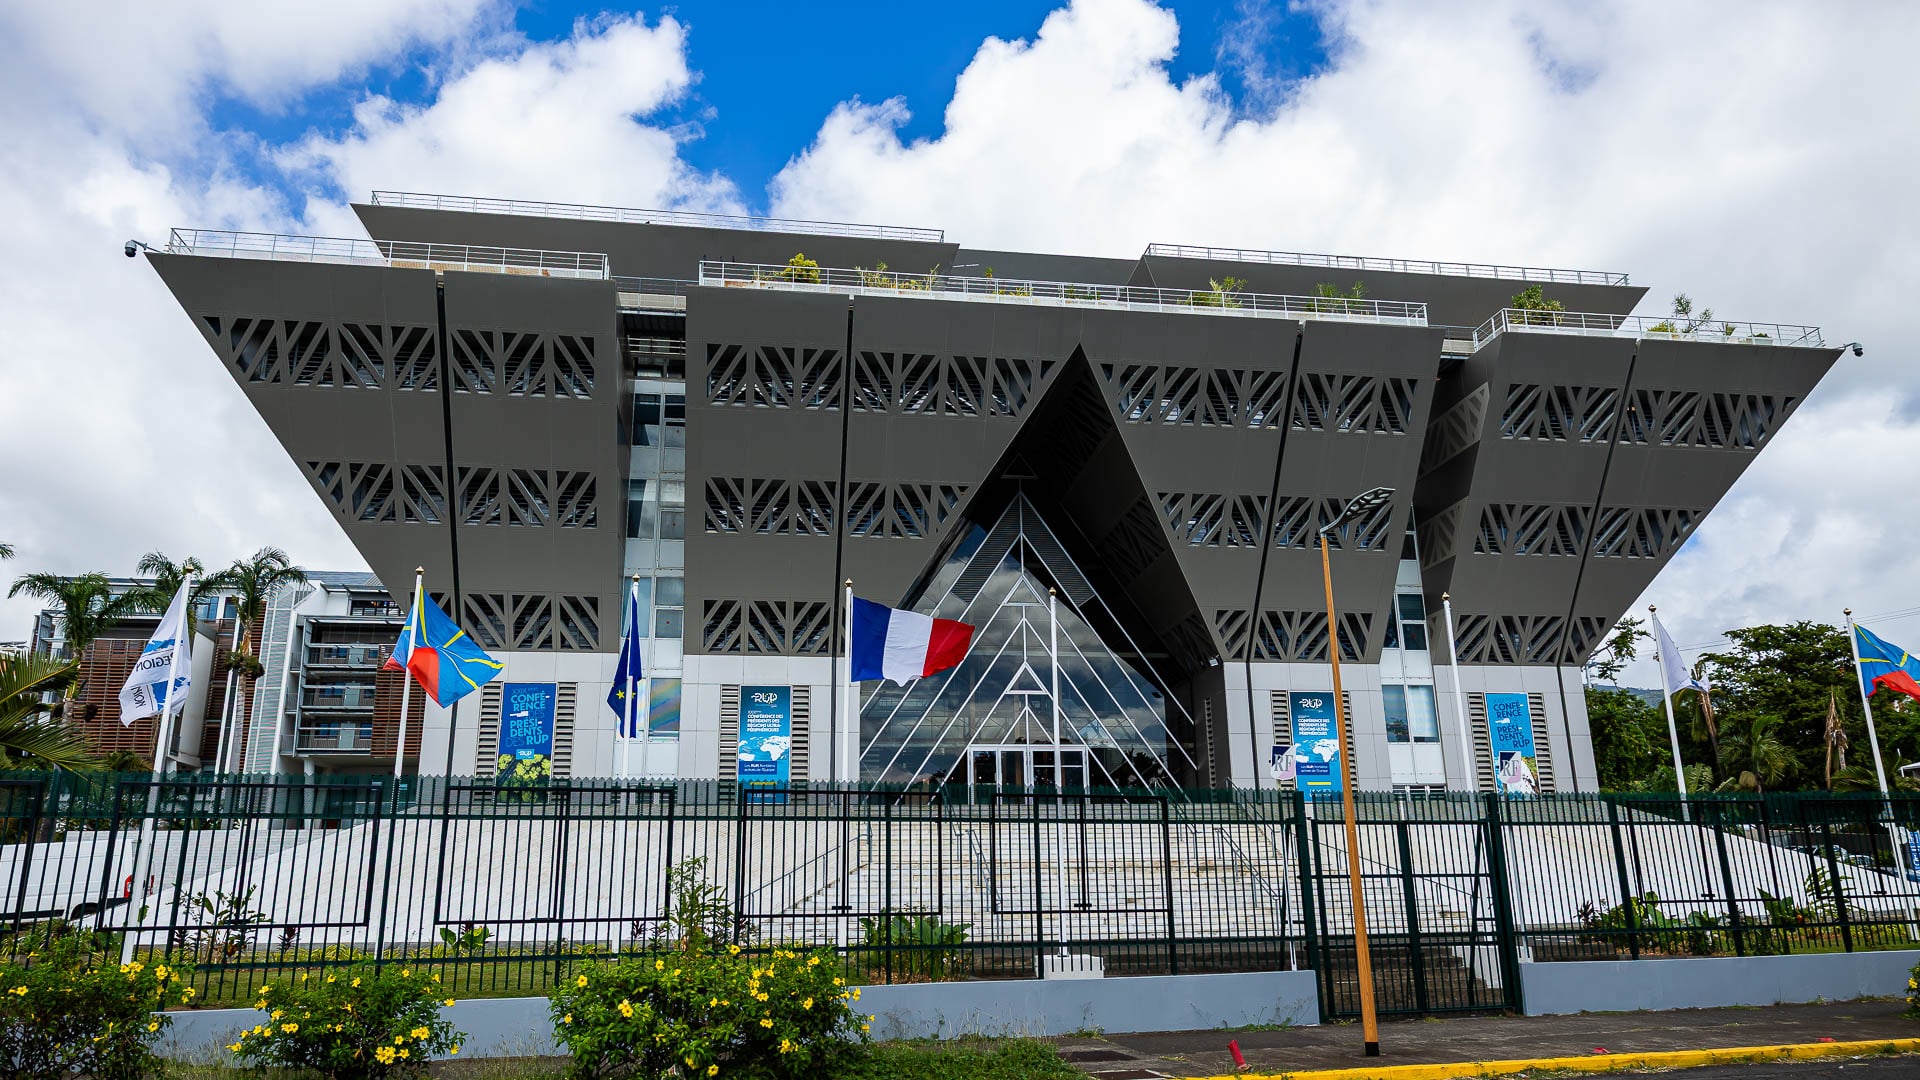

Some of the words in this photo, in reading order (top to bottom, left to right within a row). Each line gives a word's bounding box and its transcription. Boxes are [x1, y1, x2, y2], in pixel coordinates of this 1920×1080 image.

[511, 691, 550, 703] CONFÉ-
[751, 693, 778, 704] RUP
[513, 701, 545, 711] RENCE
[1496, 710, 1522, 718] RENCE
[510, 726, 543, 737] DENTS
[1499, 732, 1524, 741] DENTS
[526, 735, 549, 745] RUP
[1513, 739, 1530, 748] RUP
[1274, 754, 1293, 771] RF
[1502, 760, 1519, 776] RF
